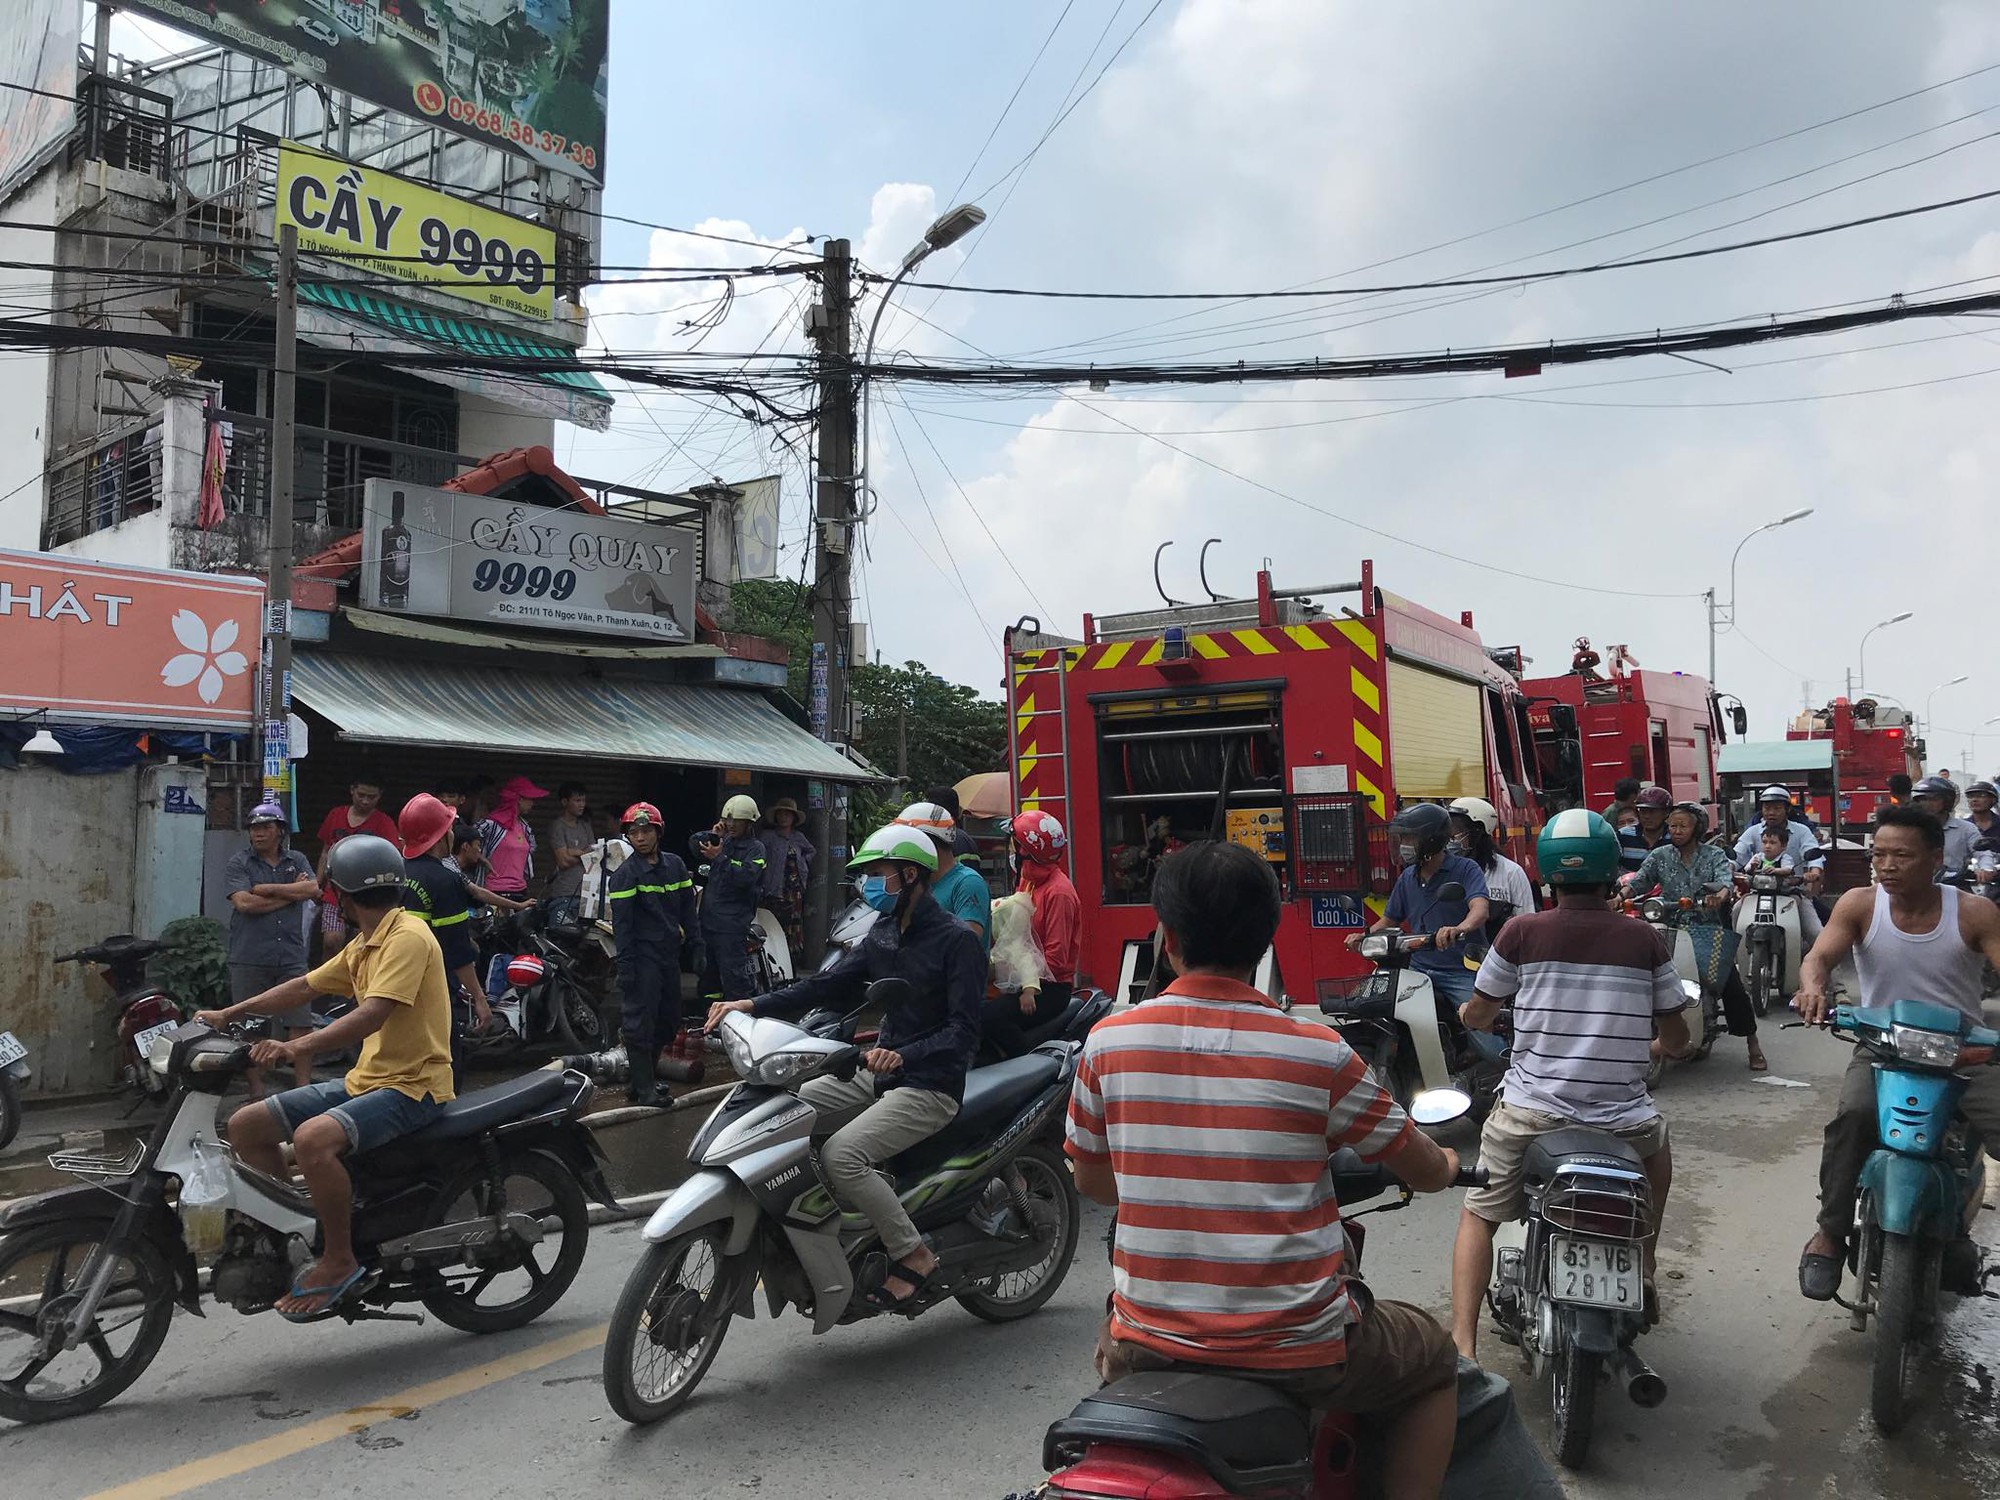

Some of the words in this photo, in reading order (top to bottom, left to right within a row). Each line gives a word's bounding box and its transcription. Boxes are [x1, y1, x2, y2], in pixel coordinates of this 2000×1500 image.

[448, 97, 596, 170] 0968.38.37.38
[289, 169, 403, 250] CẦY
[420, 218, 543, 295] 9999
[569, 532, 681, 576] QUAY
[472, 559, 576, 601] 9999
[499, 603, 515, 614] ĐC:
[518, 605, 540, 617] 211/1
[596, 613, 604, 623] P.
[653, 620, 662, 630] Q.
[663, 622, 673, 631] 12
[764, 1165, 801, 1192] YAMAHA
[1569, 1157, 1621, 1166] HONDA
[1565, 1271, 1627, 1303] 2815
